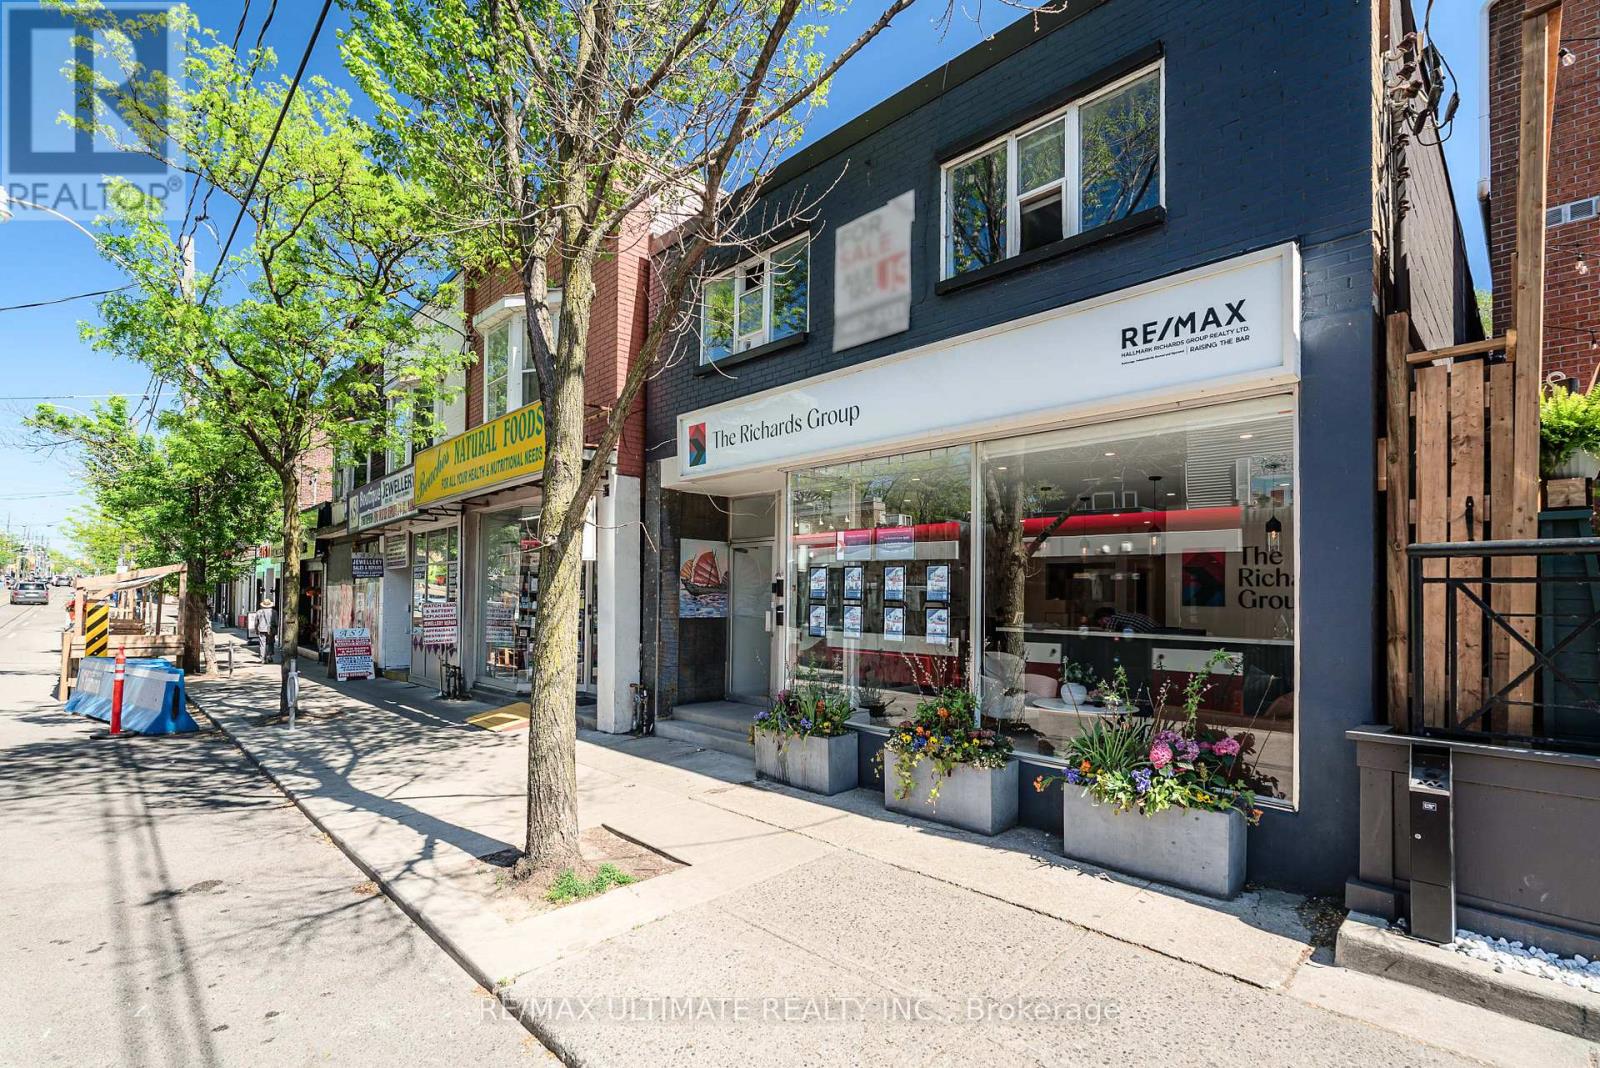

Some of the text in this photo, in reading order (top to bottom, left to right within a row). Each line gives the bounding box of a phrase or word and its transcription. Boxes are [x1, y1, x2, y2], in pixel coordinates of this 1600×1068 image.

[1121, 299, 1246, 349] RE/MAX
[1121, 346, 1153, 358] HALLMARK
[1153, 340, 1185, 351] RICHARDS
[1185, 334, 1208, 344] GROUP
[1209, 328, 1235, 339] REALTY
[1189, 334, 1251, 353] RAISING THE BAR
[454, 424, 498, 465] NATURAL
[503, 404, 545, 448] FOODS
[713, 404, 860, 449] The Richards Group
[524, 446, 543, 464] NEEDS
[1242, 546, 1283, 566] The
[1239, 568, 1294, 587] Rich
